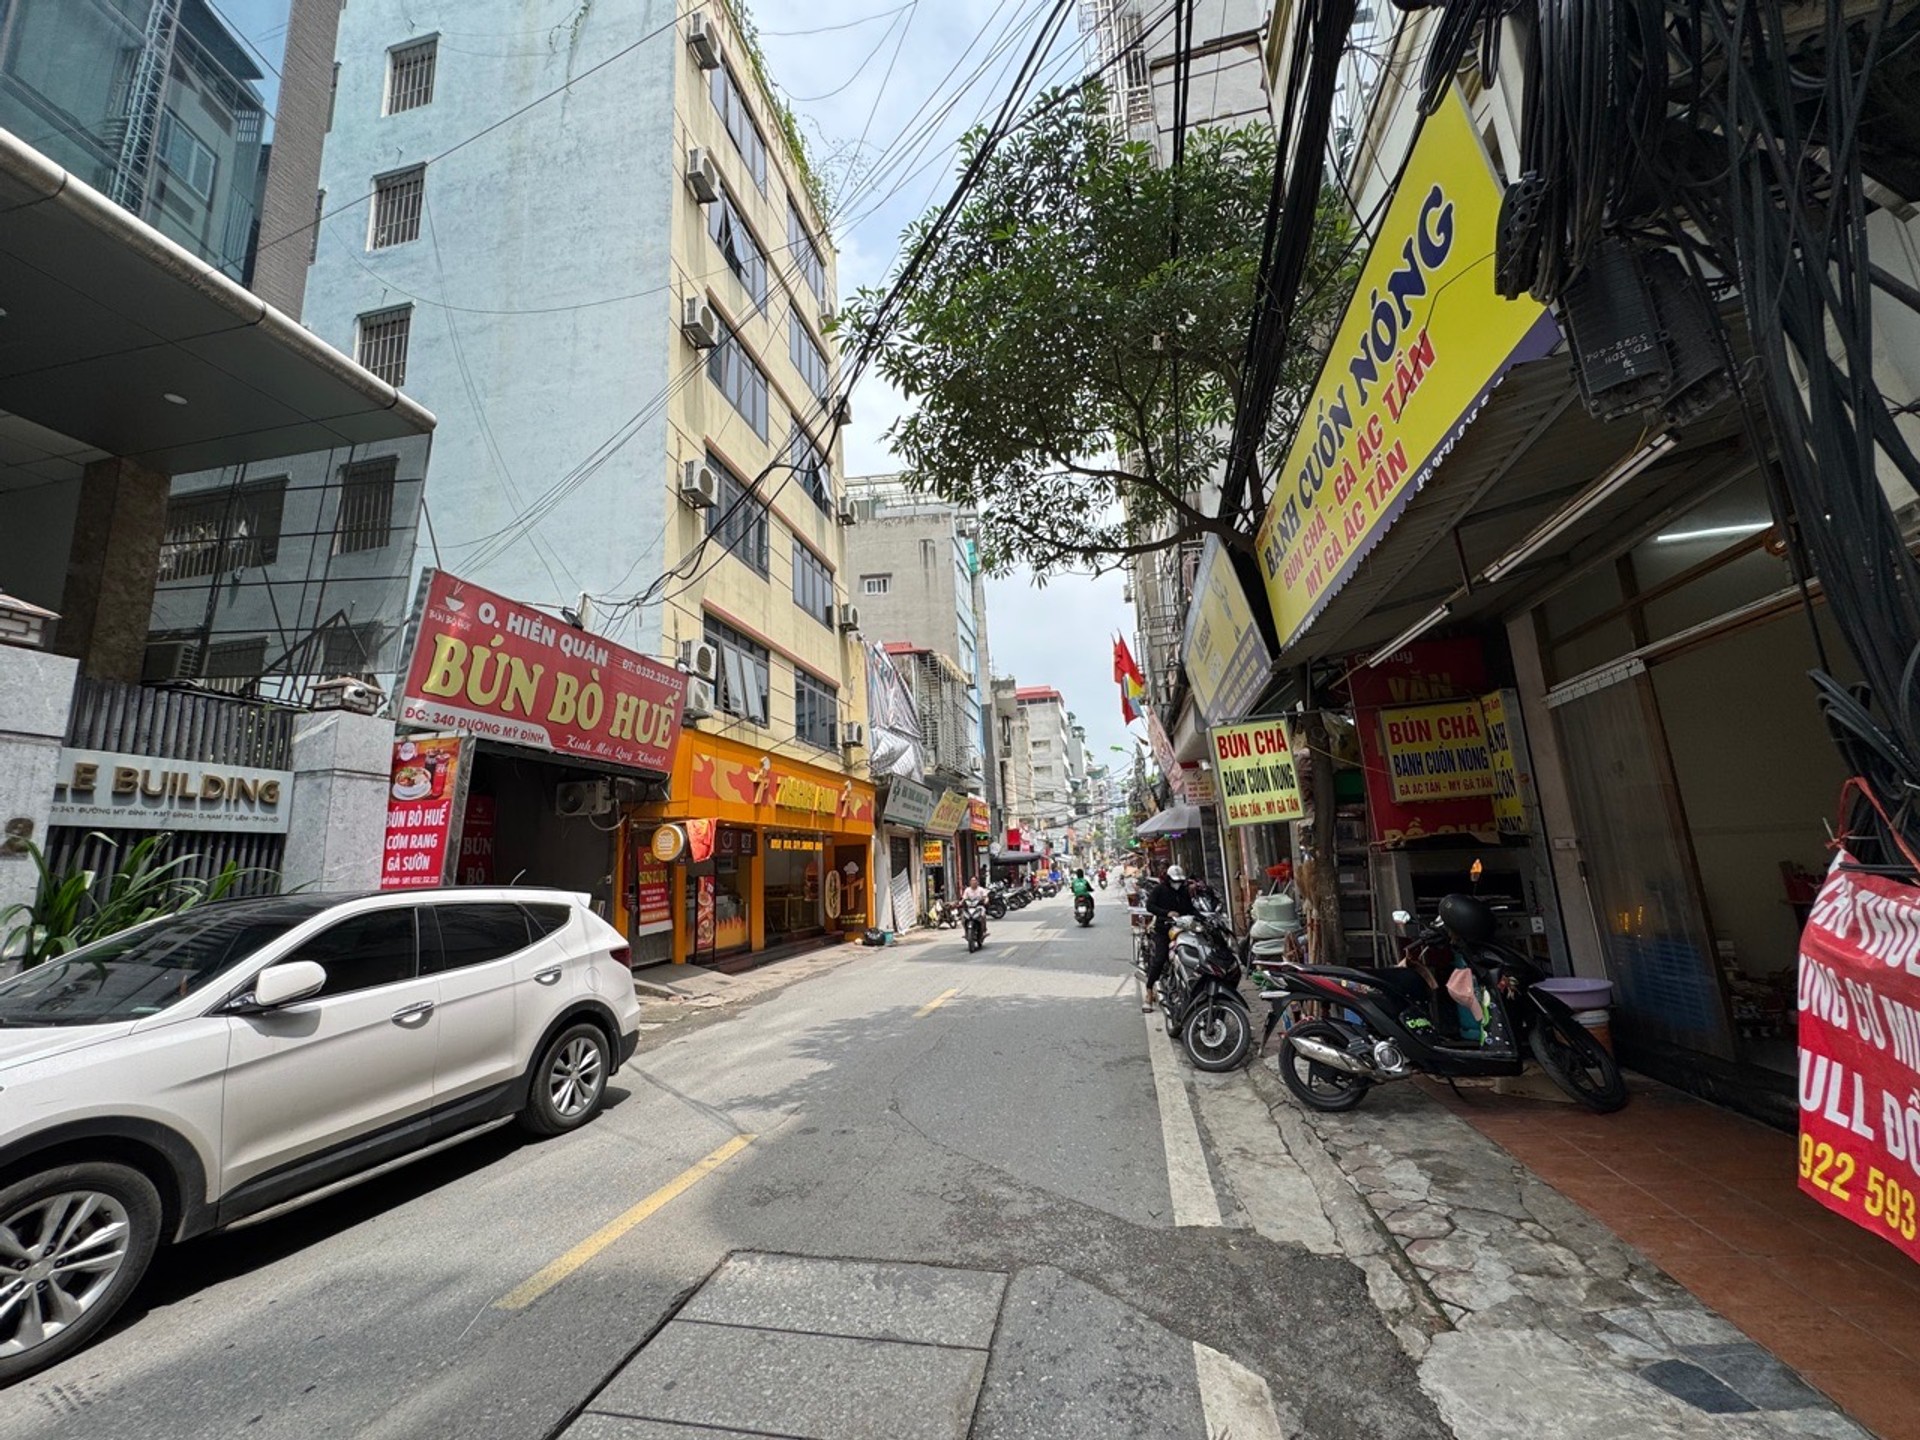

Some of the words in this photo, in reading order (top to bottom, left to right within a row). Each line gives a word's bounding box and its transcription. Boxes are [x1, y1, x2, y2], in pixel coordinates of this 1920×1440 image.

[1264, 493, 1301, 580] BÁNH
[1299, 385, 1354, 512] CUỐN
[1350, 185, 1454, 406] NÓNG
[1283, 547, 1304, 591] BÚN
[1303, 504, 1327, 558] CHẢ
[1334, 457, 1357, 503] GÀ
[1356, 413, 1384, 469] ÁC
[1382, 327, 1437, 423] TẦN
[1323, 529, 1344, 569] GÀ
[1343, 503, 1366, 549] ÁC
[1365, 440, 1409, 515] TẦN
[478, 602, 500, 628] O.
[506, 613, 555, 647] HIỀN
[559, 633, 609, 667] QUÁN
[422, 634, 545, 717] BÚN
[547, 668, 605, 731] BÒ
[609, 690, 681, 750] HUẾ
[404, 707, 429, 723] ĐC:
[432, 711, 455, 727] 340
[520, 725, 545, 744] ĐÌNH
[1217, 730, 1251, 760] BÚN
[1254, 722, 1288, 755] CHẢ
[1388, 716, 1432, 745] BÚN
[1437, 706, 1481, 740] CHẢ
[1223, 766, 1248, 797] BÁNH
[1269, 759, 1296, 791] NÓNG
[1393, 748, 1424, 777] BÁNH
[1458, 743, 1489, 773] NÓNG
[55, 762, 99, 790] E
[112, 765, 280, 804] BUILDING
[407, 805, 423, 827] BÒ
[424, 801, 449, 826] HUẾ
[386, 833, 408, 850] CƠM
[410, 833, 438, 848] RANG
[462, 832, 493, 856] BÚN
[387, 853, 400, 871] GÀ
[402, 852, 430, 871] SƯỜN
[1798, 1046, 1875, 1140] ULL
[1864, 1165, 1916, 1241] 593
